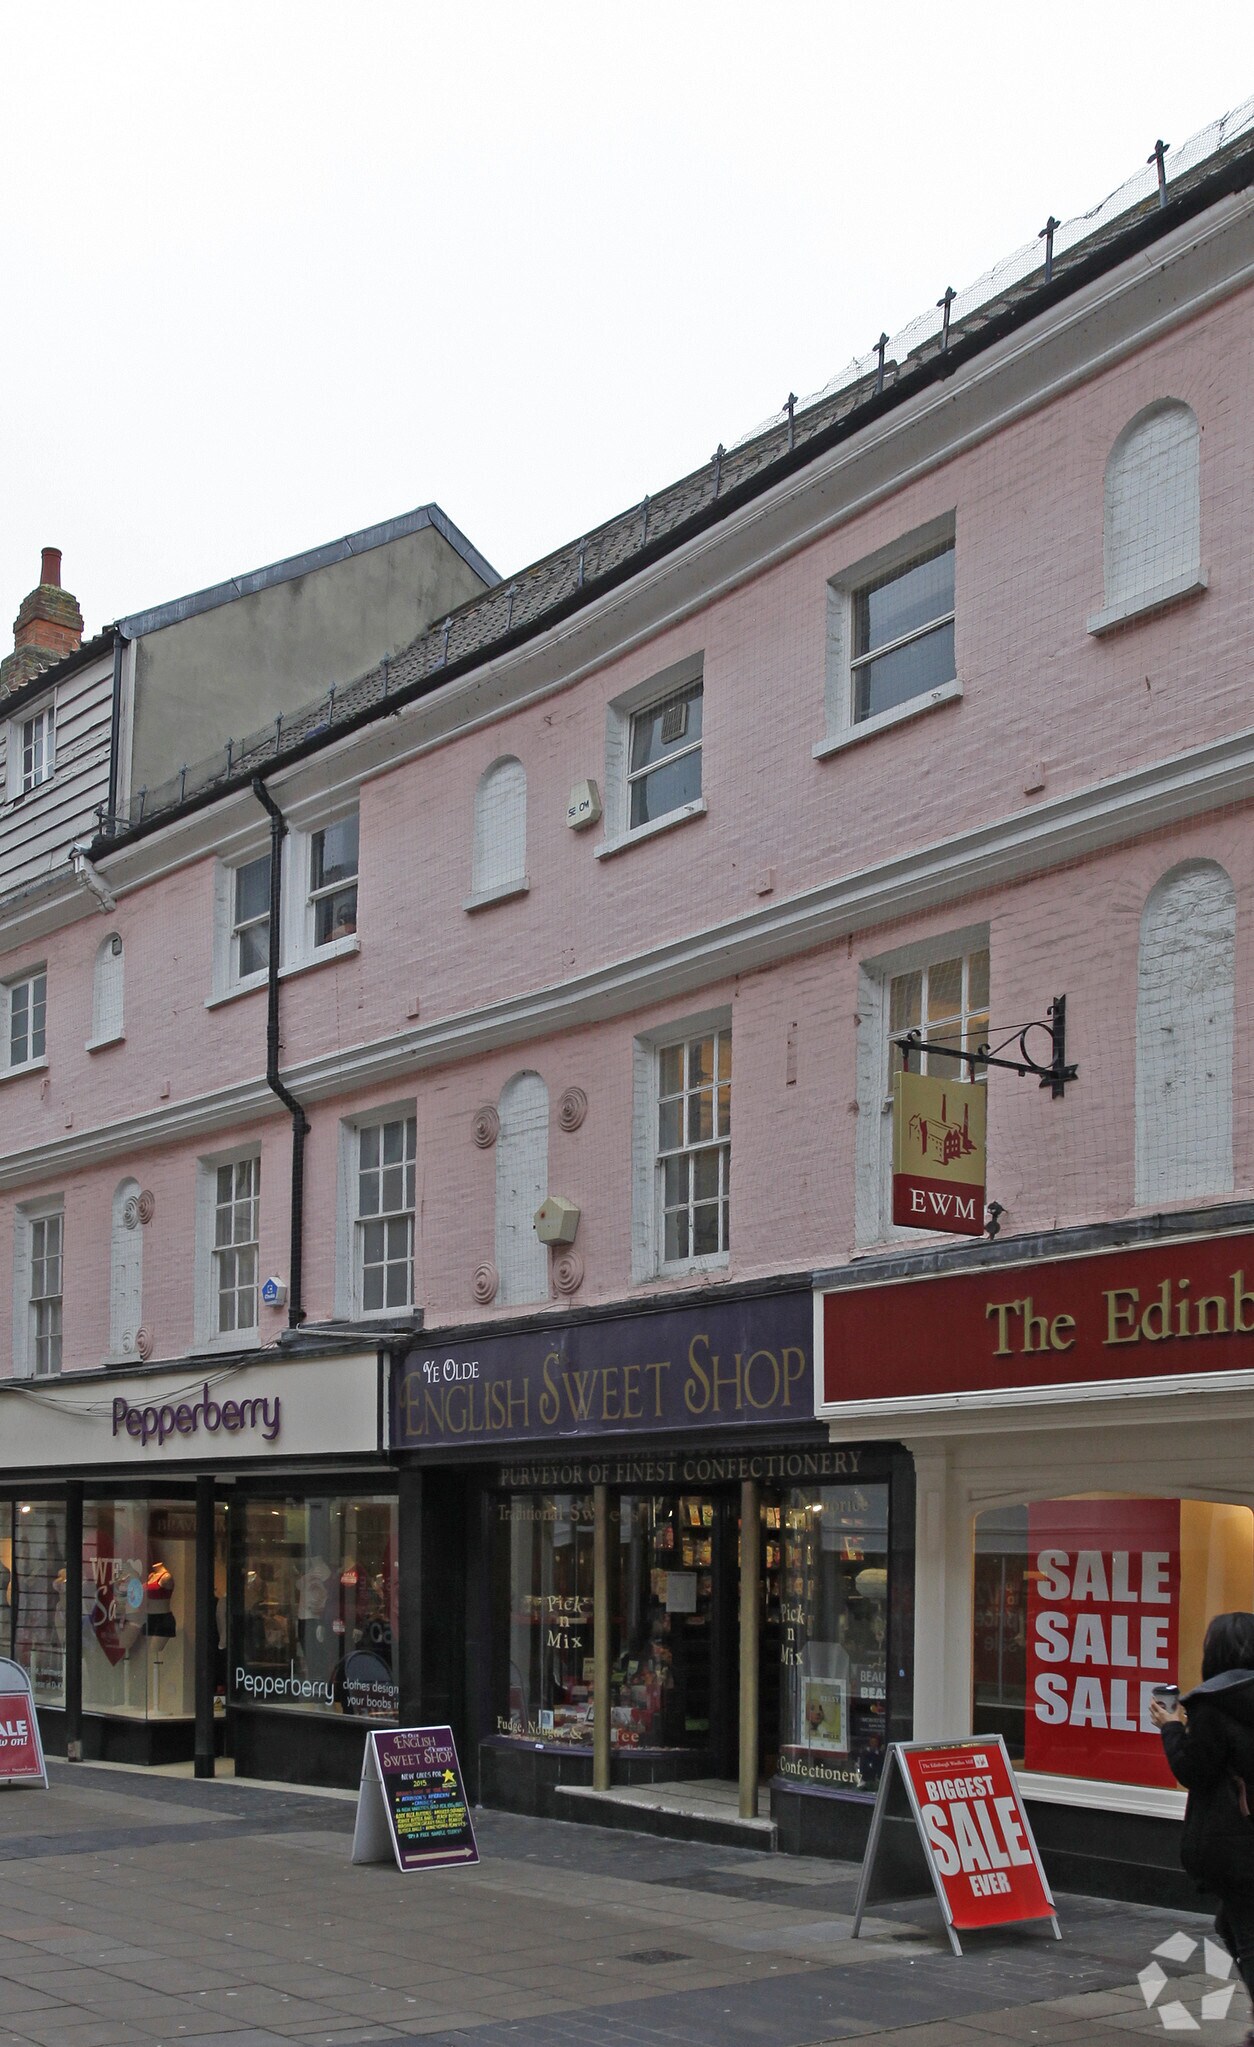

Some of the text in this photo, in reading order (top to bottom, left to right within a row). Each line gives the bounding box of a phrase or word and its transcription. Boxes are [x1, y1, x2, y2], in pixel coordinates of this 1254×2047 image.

[909, 1188, 976, 1220] EWM
[985, 1269, 1254, 1355] The Edinb
[443, 1358, 480, 1382] OLDE
[400, 1334, 806, 1437] ENGLISH SWEET SHOP
[112, 1382, 280, 1447] Pepperberry
[500, 1464, 583, 1487] PURVEYOR
[589, 1462, 609, 1484] OF
[616, 1460, 677, 1483] FINEST
[683, 1450, 862, 1480] CONFECTIONERY
[1036, 1549, 1171, 1604] SALE
[548, 1595, 584, 1613] Pick
[780, 1602, 805, 1625] Pick
[559, 1615, 570, 1628] n
[787, 1627, 795, 1641] n
[547, 1630, 583, 1649] Mix
[1034, 1611, 1170, 1670] SALE
[780, 1643, 804, 1666] Mix
[235, 1658, 335, 1706] Pepperberry
[343, 1678, 370, 1691] clothes
[347, 1695, 364, 1707] your
[366, 1694, 392, 1710] boobs
[497, 1715, 525, 1734] Fudge,
[569, 1726, 583, 1740] &
[393, 1735, 436, 1749] ENGLISH
[383, 1748, 453, 1767] SWEET SHOP
[780, 1755, 862, 1787] Confectionery
[925, 1775, 995, 1802] BIGGEST
[921, 1796, 1034, 1877] SALE
[968, 1871, 1012, 1897] EVER
